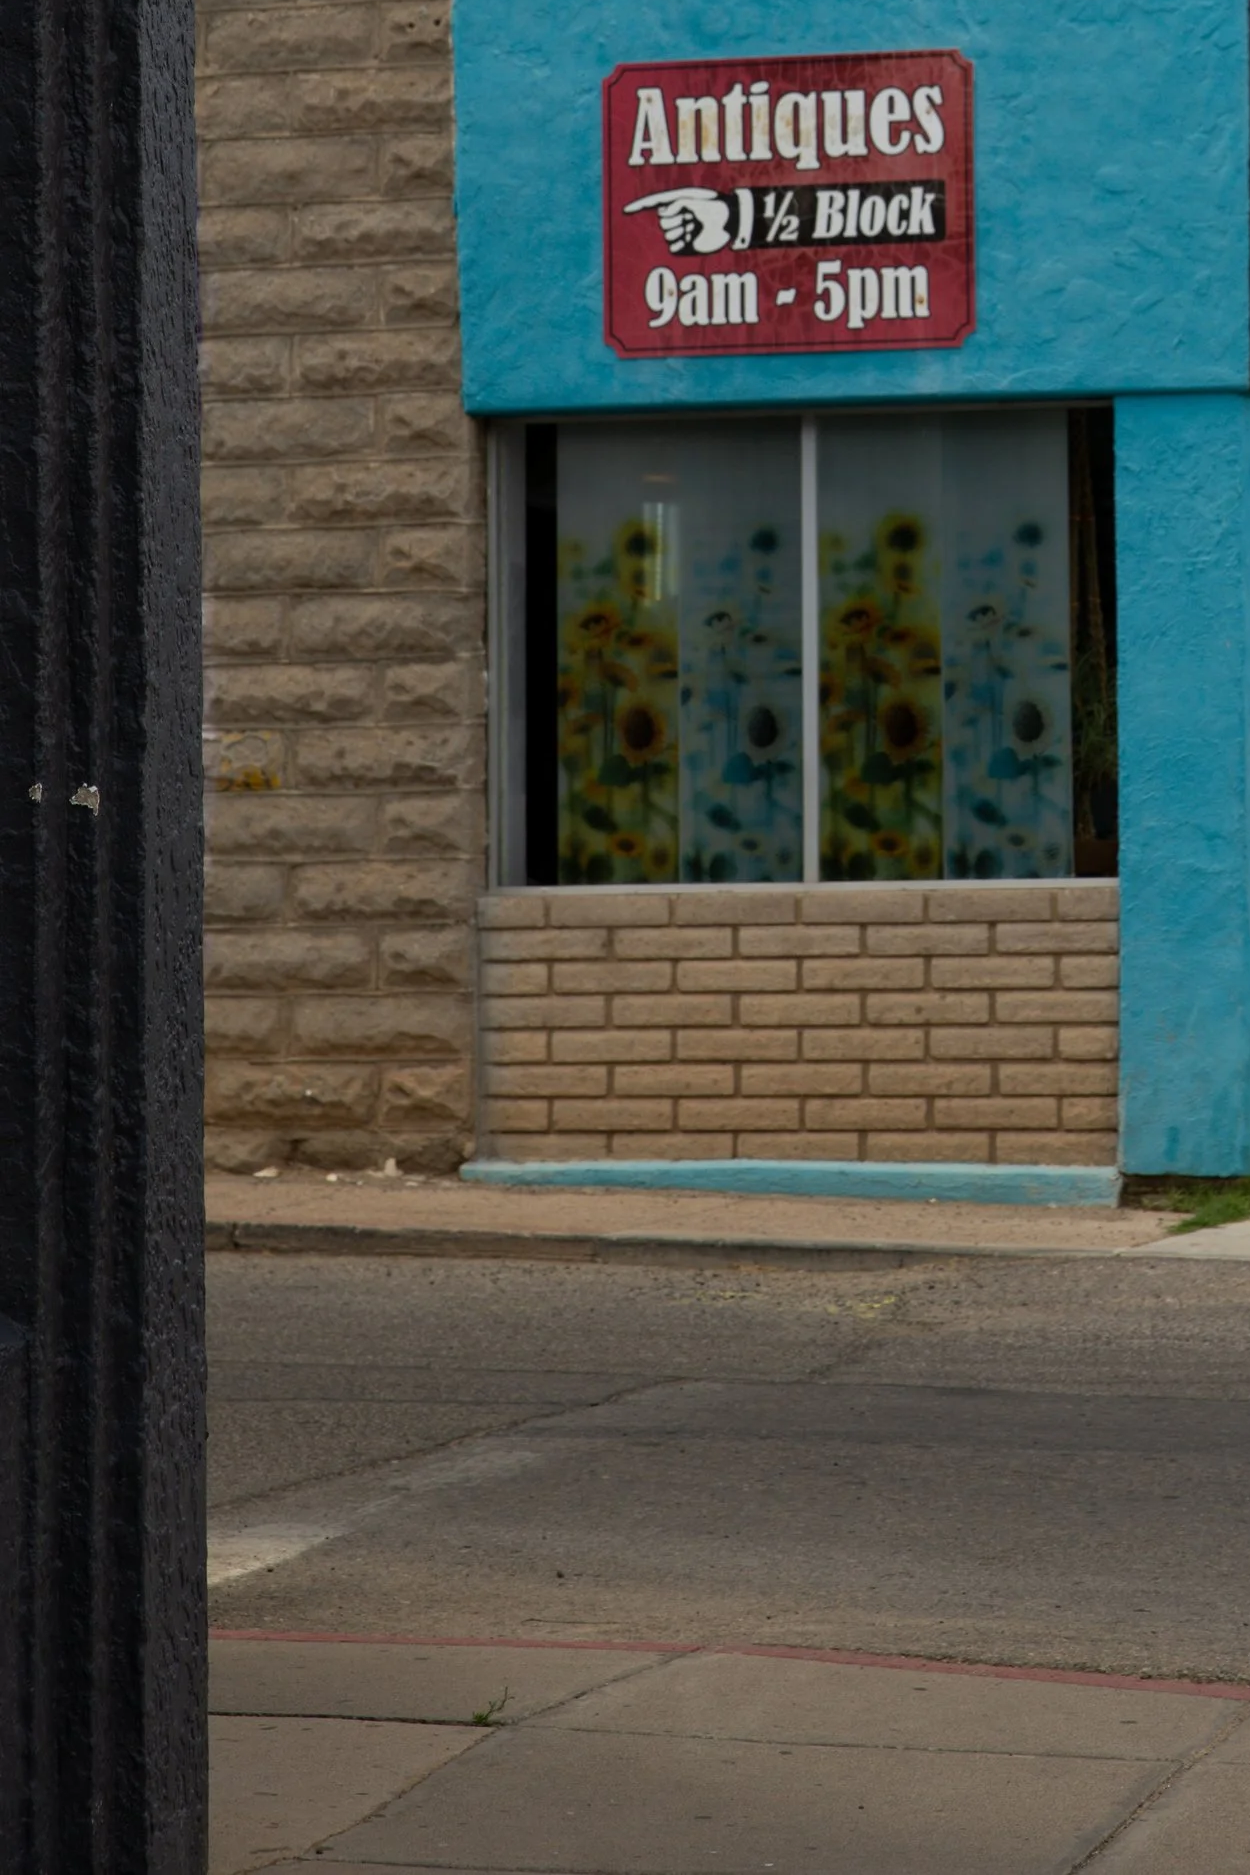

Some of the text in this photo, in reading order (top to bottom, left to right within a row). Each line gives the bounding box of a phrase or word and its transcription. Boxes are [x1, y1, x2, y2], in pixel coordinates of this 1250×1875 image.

[628, 80, 946, 170] Antiques
[812, 186, 937, 239] Block
[645, 265, 759, 329] 9am
[813, 259, 931, 330] 5pm
